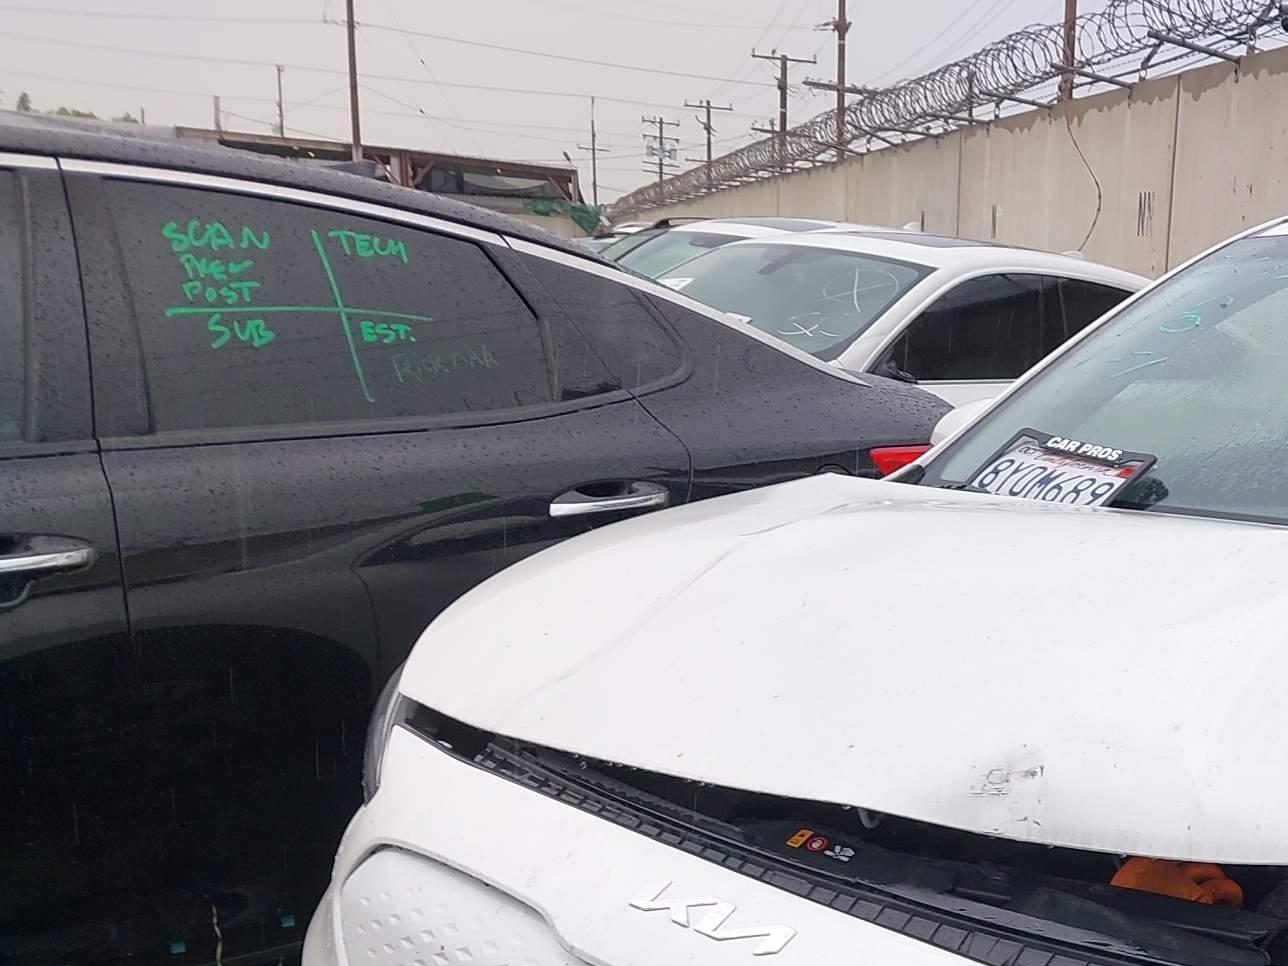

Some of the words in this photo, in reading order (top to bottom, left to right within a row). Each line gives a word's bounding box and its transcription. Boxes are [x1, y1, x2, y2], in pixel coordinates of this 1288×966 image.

[162, 220, 270, 251] SCAN
[181, 281, 261, 304] POST
[207, 313, 275, 349] SUB
[1046, 436, 1080, 453] CAR
[1078, 443, 1123, 461] PROS
